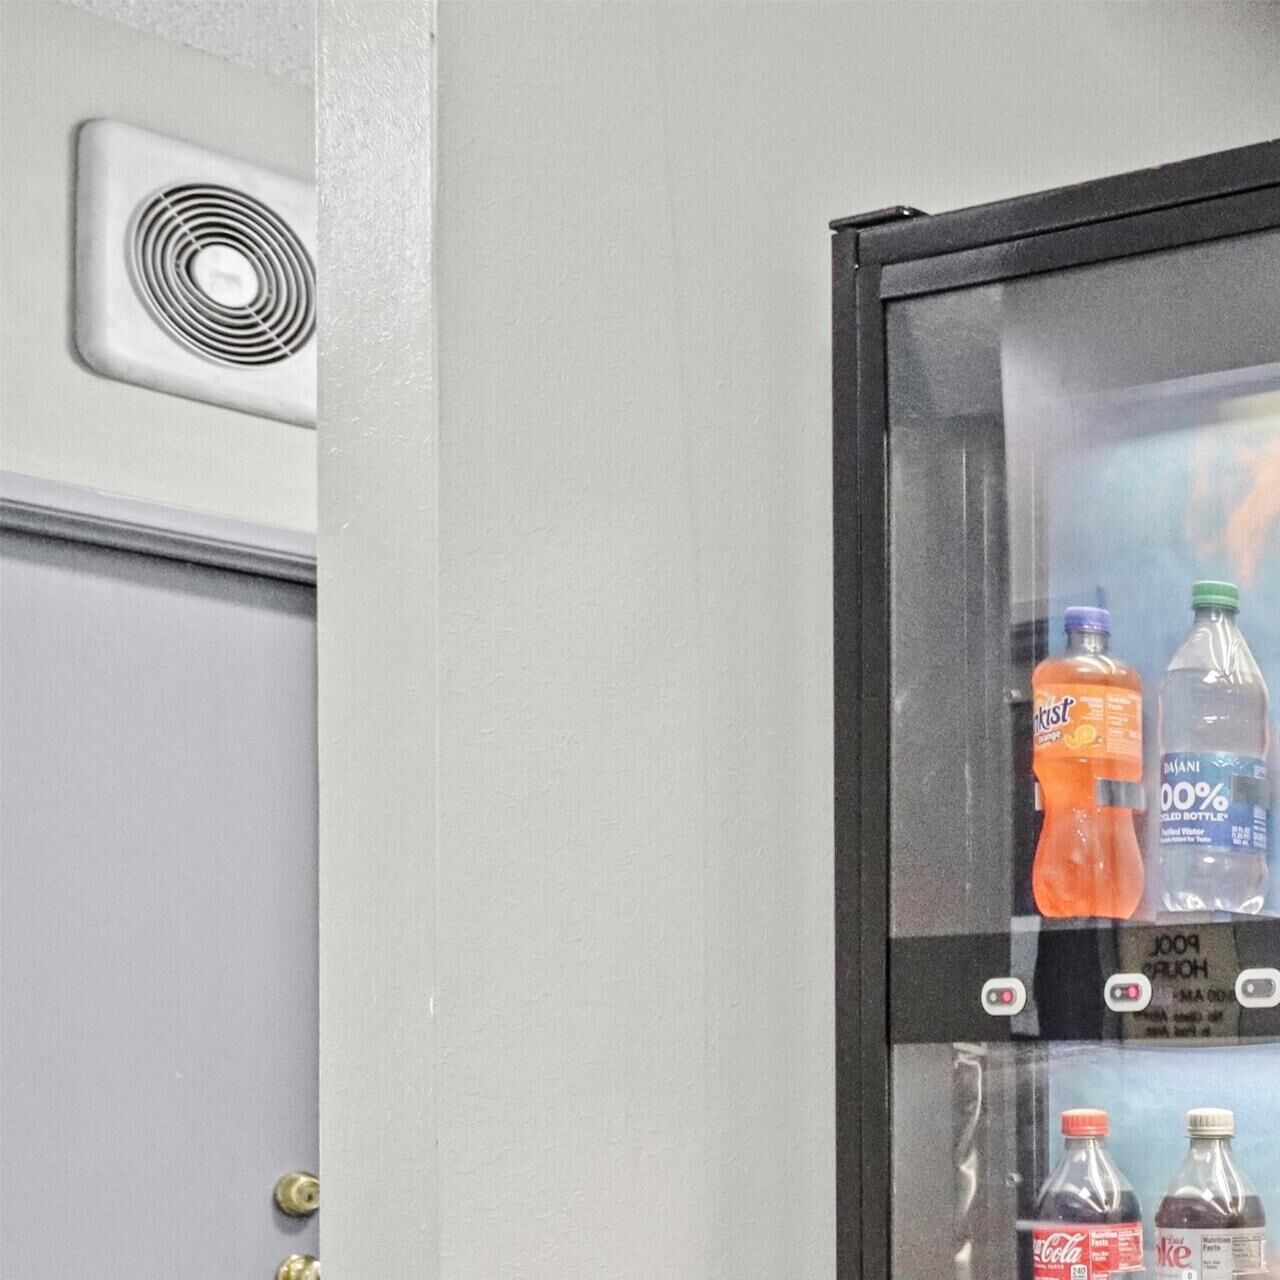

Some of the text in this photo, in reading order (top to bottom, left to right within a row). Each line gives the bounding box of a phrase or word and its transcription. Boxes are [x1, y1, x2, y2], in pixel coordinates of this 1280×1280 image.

[1163, 757, 1200, 776] DASANI
[1202, 1244, 1221, 1252] Facts
[1072, 1268, 1087, 1276] 240
